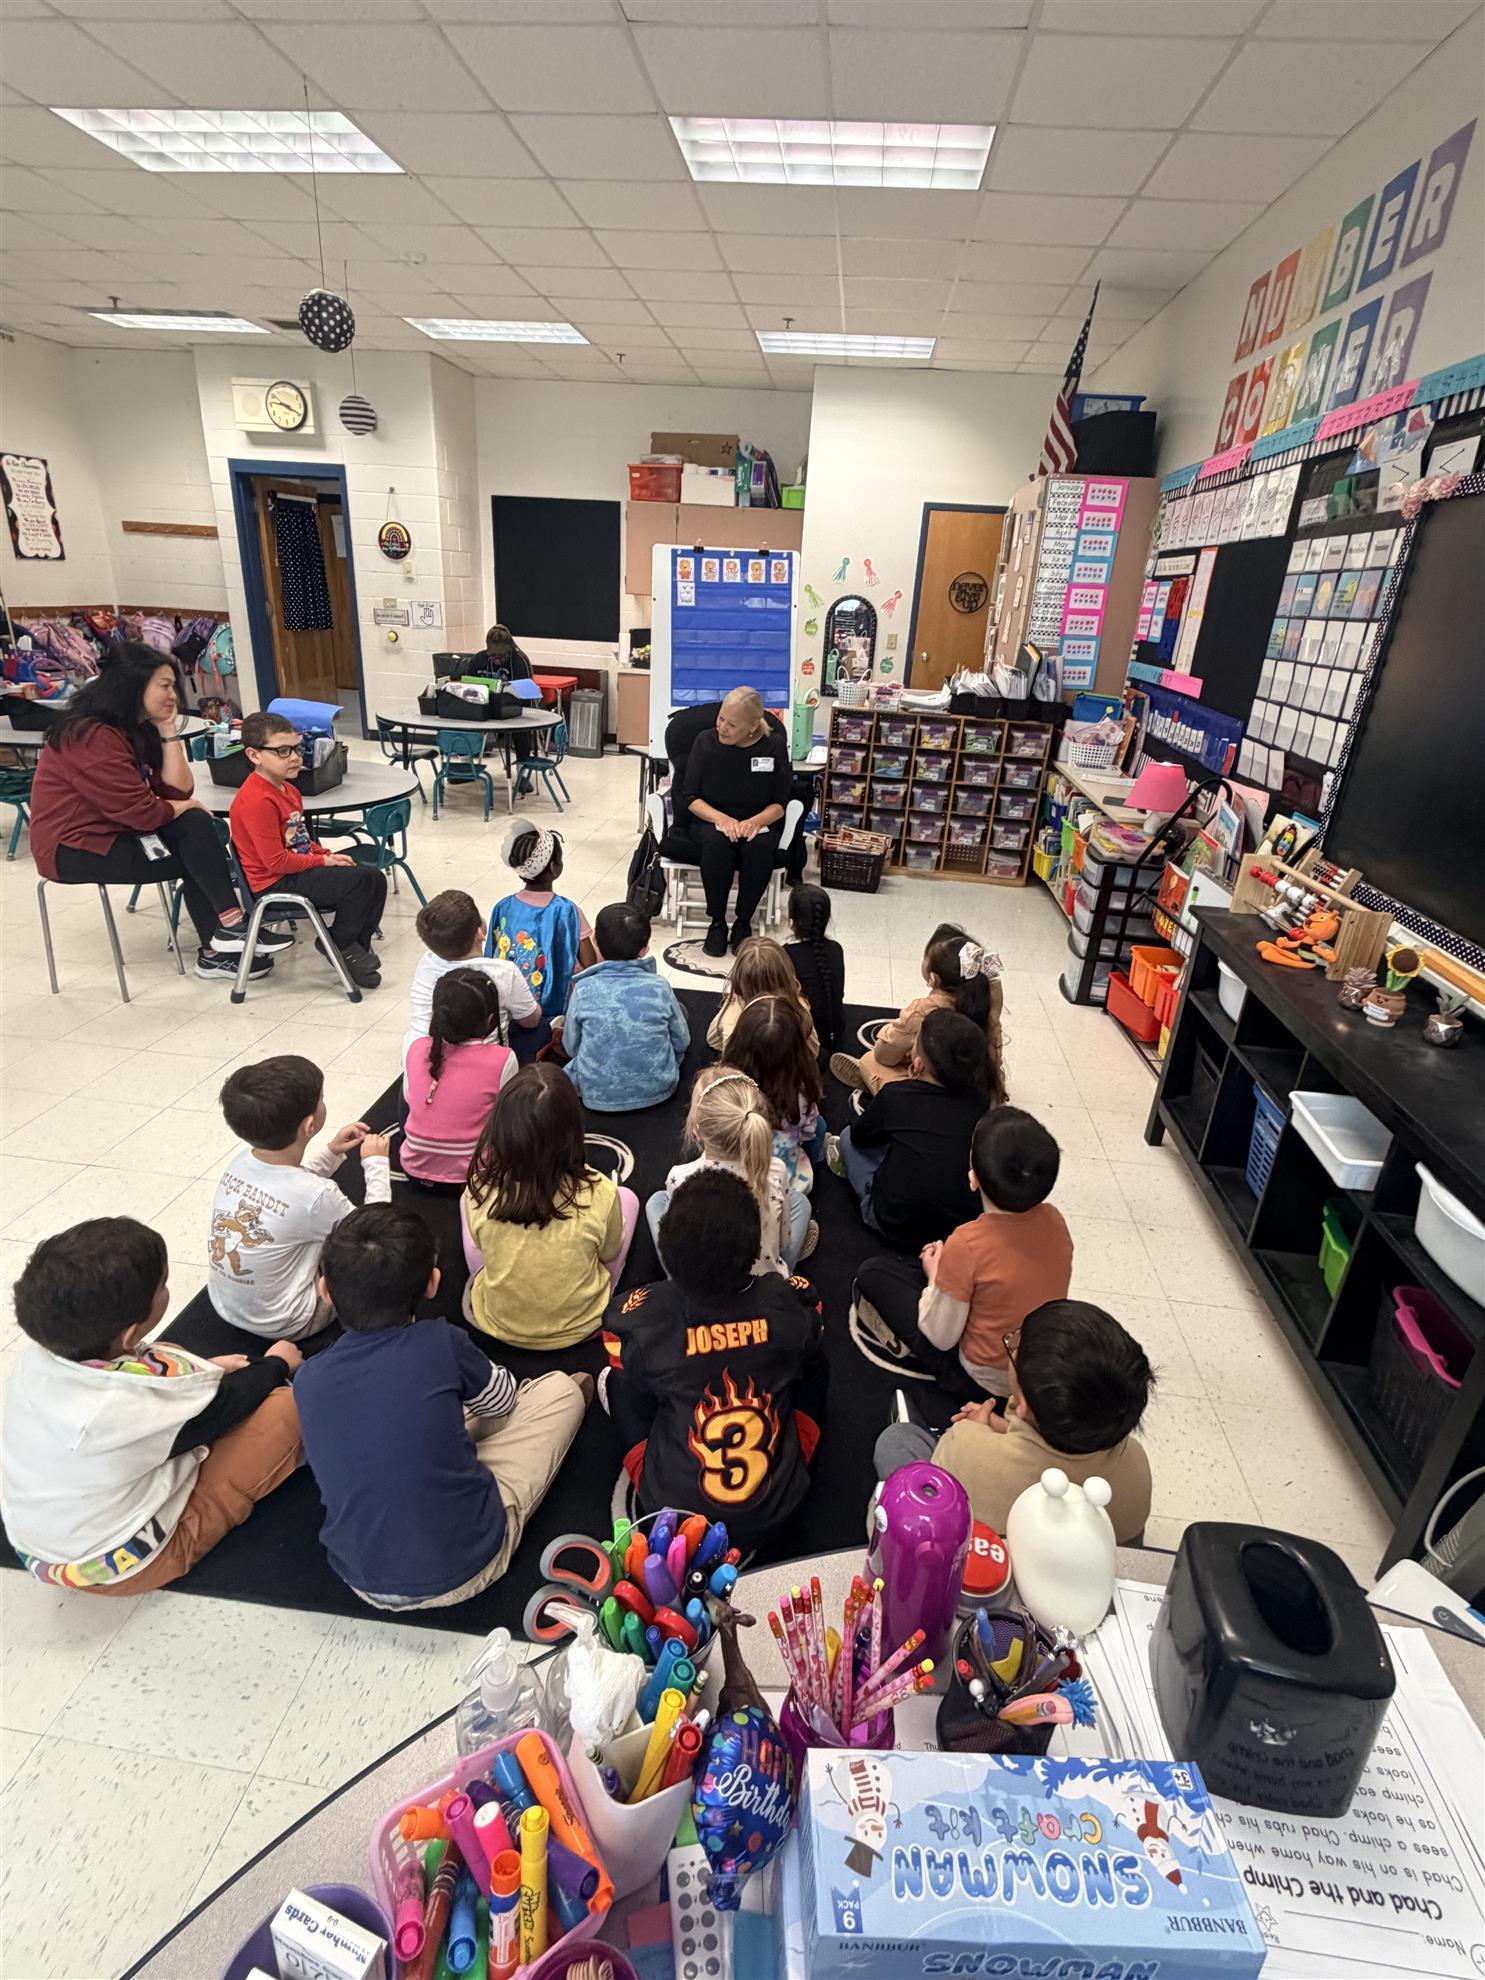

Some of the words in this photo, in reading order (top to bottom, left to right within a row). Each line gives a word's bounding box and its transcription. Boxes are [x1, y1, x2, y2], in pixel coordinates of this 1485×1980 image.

[1238, 155, 1460, 355] NUMBER
[1220, 302, 1418, 450] CORNER
[1054, 541, 1068, 551] May
[243, 1184, 290, 1217] BANDIT
[685, 1318, 769, 1357] JOSEPH
[701, 1405, 775, 1505] 3
[1371, 1744, 1402, 1758] see
[1377, 1766, 1416, 1785] looks
[1381, 1785, 1425, 1808] chimp
[926, 1805, 982, 1848] kit
[1238, 1814, 1259, 1834] his
[1263, 1818, 1297, 1838] rubs
[1351, 1808, 1390, 1829] looks
[1395, 1814, 1416, 1833] he
[1418, 1818, 1436, 1831] as
[1300, 1824, 1341, 1847] Chad
[1342, 1828, 1392, 1854] chimp.
[1396, 1839, 1408, 1852] a
[1225, 1838, 1265, 1859] when
[1271, 1846, 1312, 1869] home
[1318, 1849, 1347, 1868] way
[1412, 1842, 1449, 1859] sees
[890, 1846, 1151, 1910] SNOWMAN
[1352, 1859, 1376, 1879] his
[1379, 1863, 1398, 1877] on
[1404, 1867, 1418, 1882] is
[1242, 1864, 1304, 1898] Chimp
[1307, 1879, 1344, 1905] the
[1422, 1870, 1464, 1893] Chad
[837, 1899, 860, 1910] PACK
[1346, 1885, 1384, 1907] and
[1388, 1892, 1443, 1921] Chad
[284, 1904, 319, 1934] Cards
[843, 1910, 856, 1931] 9
[1166, 1914, 1247, 1936] BANBBUR
[1423, 1934, 1467, 1957] Name:
[922, 1952, 1159, 1980] SNOWMAN
